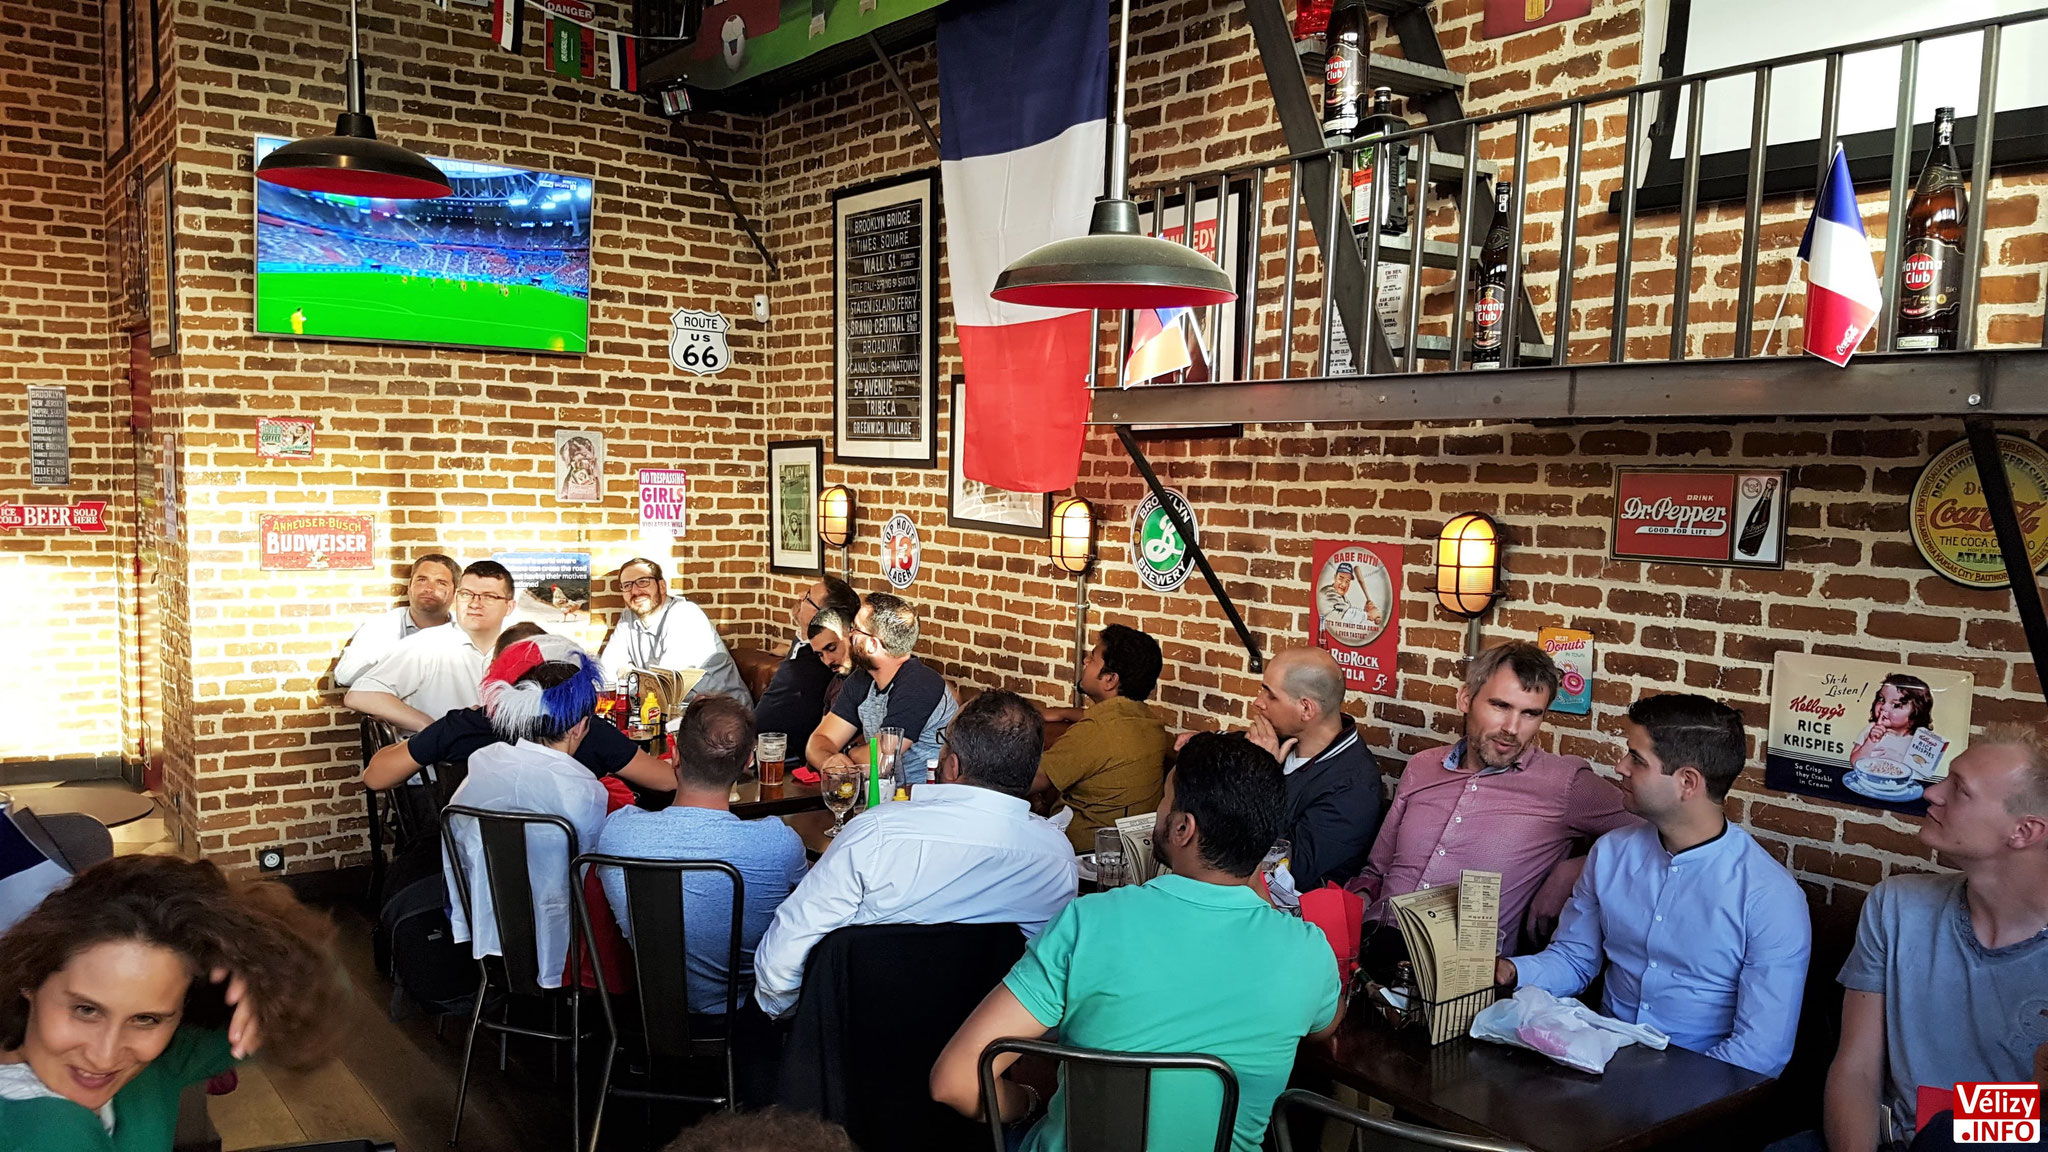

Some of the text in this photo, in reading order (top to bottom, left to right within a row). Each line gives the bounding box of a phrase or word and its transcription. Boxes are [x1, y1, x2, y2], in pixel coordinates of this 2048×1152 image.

[547, 2, 593, 19] DANGER
[1327, 69, 1343, 81] Club
[854, 210, 911, 234] BROOKLYN BRIDGE
[856, 231, 909, 253] TIMES SQUARE
[863, 255, 884, 274] WALL
[898, 276, 916, 287] STATION
[1905, 271, 1931, 284] Club
[850, 295, 917, 315] STATEN ISLAND FERRY
[684, 316, 718, 330] ROUTE
[1477, 313, 1497, 322] Club
[850, 320, 872, 336] GRAND
[874, 316, 905, 333] CENTRAL
[690, 333, 711, 342] US
[862, 338, 901, 354] BROADWAY
[682, 344, 719, 368] 66
[849, 362, 870, 374] CANAL
[31, 390, 64, 399] BROOKLYN
[864, 379, 893, 396] AVENUE
[866, 400, 896, 416] TRIBECA
[32, 426, 64, 434] BROADWAY
[853, 421, 912, 435] GREENWICH VILLAGE
[33, 442, 44, 450] THE
[34, 466, 66, 475] QUEENS
[641, 472, 684, 484] NO TRESPASSING
[1931, 455, 1975, 499] DELICIOU
[642, 487, 684, 503] GIRLS
[1687, 494, 1714, 502] DRINK
[1, 508, 16, 516] ICE
[23, 507, 72, 526] BEER
[73, 508, 98, 517] SOLD
[643, 504, 682, 520] ONLY
[1139, 494, 1190, 524] BROLYN
[74, 516, 98, 524] HERE
[1930, 499, 2047, 535] Coca-Cla
[267, 532, 367, 554] BUDWEISER
[1940, 536, 1958, 546] THE
[888, 536, 913, 570] 13
[1333, 552, 1379, 567] BABE RUTH
[1956, 552, 2005, 564] ATLANT
[1138, 556, 1186, 585] BREWERY
[1934, 551, 1975, 580] KANSAS CITY
[888, 566, 912, 583] LAGER
[1975, 573, 2009, 582] BALTIMOR
[1545, 638, 1586, 653] Donuts
[1341, 667, 1365, 681] OLA
[1821, 673, 1848, 685] Sh-h
[1789, 695, 1846, 720] Kellogg's
[1798, 719, 1831, 735] RICE
[1783, 733, 1844, 754] KRISPIES
[1911, 743, 1935, 759] KRISPIES
[1918, 740, 1932, 751] RICE
[1794, 762, 1823, 775] So Crisp
[1795, 770, 1833, 783] they Crackle
[1808, 779, 1830, 789] Cream
